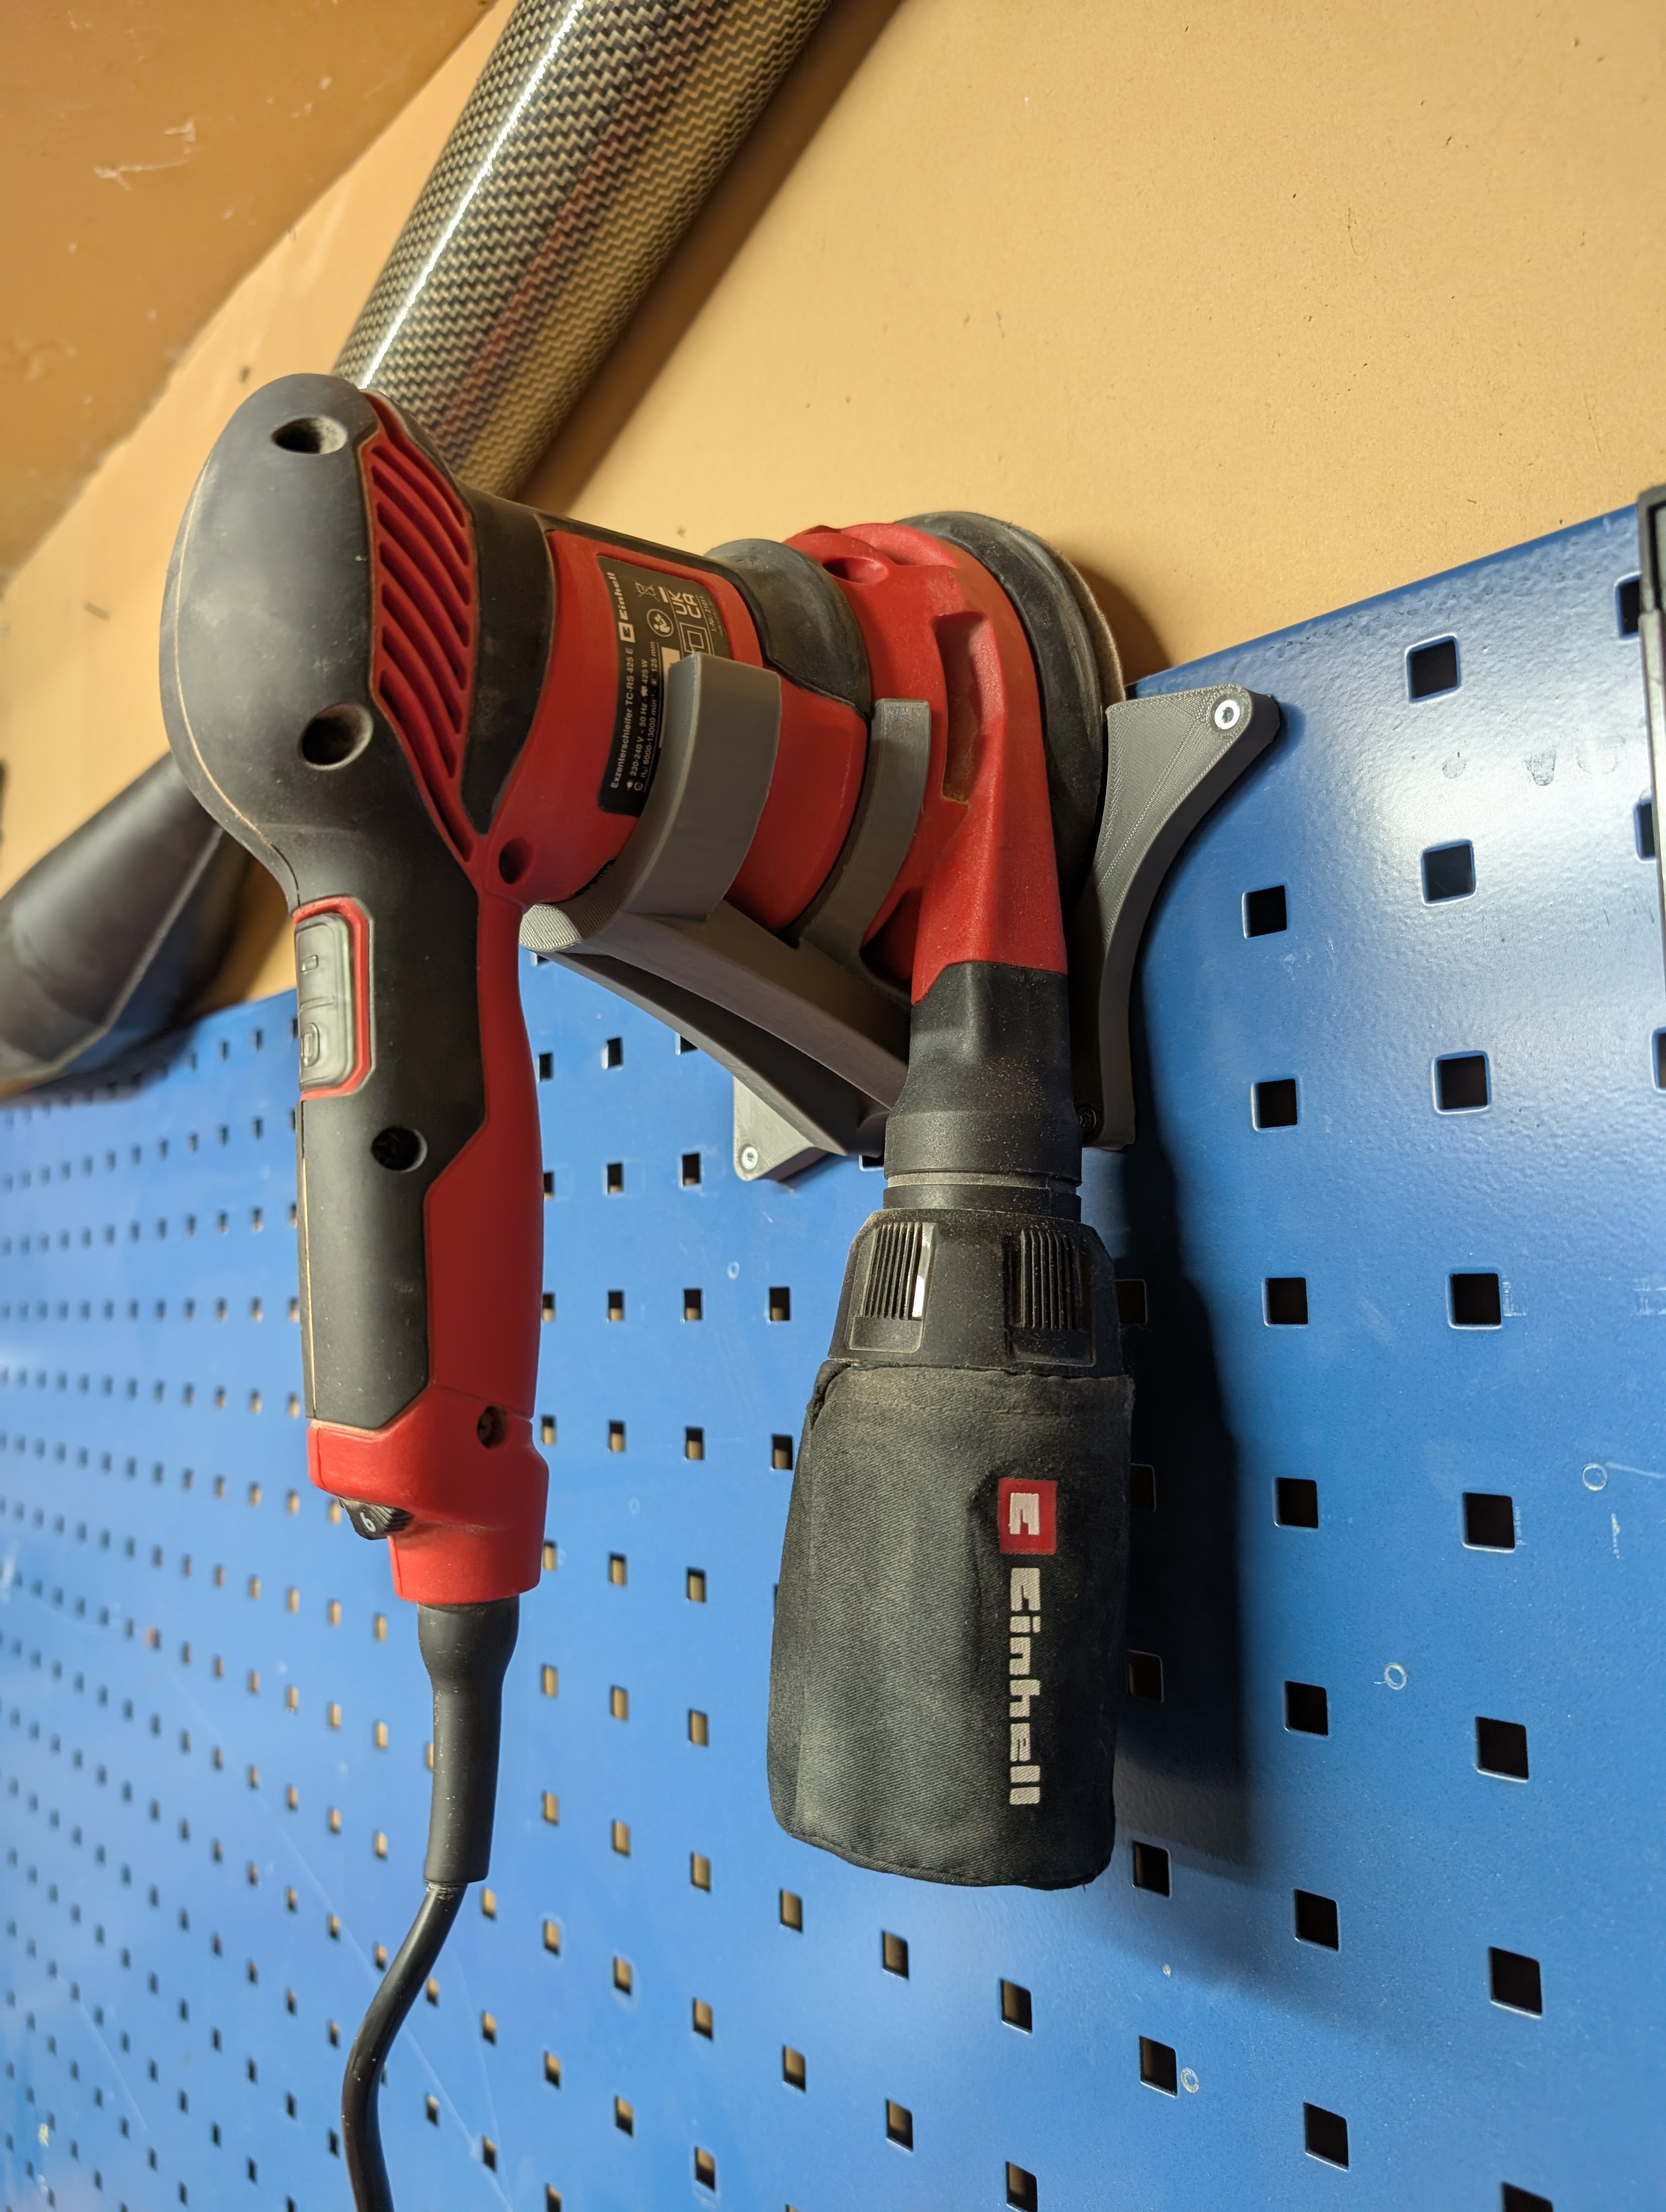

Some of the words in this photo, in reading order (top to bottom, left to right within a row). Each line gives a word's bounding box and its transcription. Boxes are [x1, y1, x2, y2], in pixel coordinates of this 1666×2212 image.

[607, 571, 629, 620] Einhell
[667, 589, 688, 615] UK
[682, 593, 702, 619] CA
[640, 704, 648, 714] Hz
[610, 708, 632, 788] Exzenterschleifer
[625, 676, 634, 705] TC-RS
[1009, 1567, 1041, 1805] Einhell
